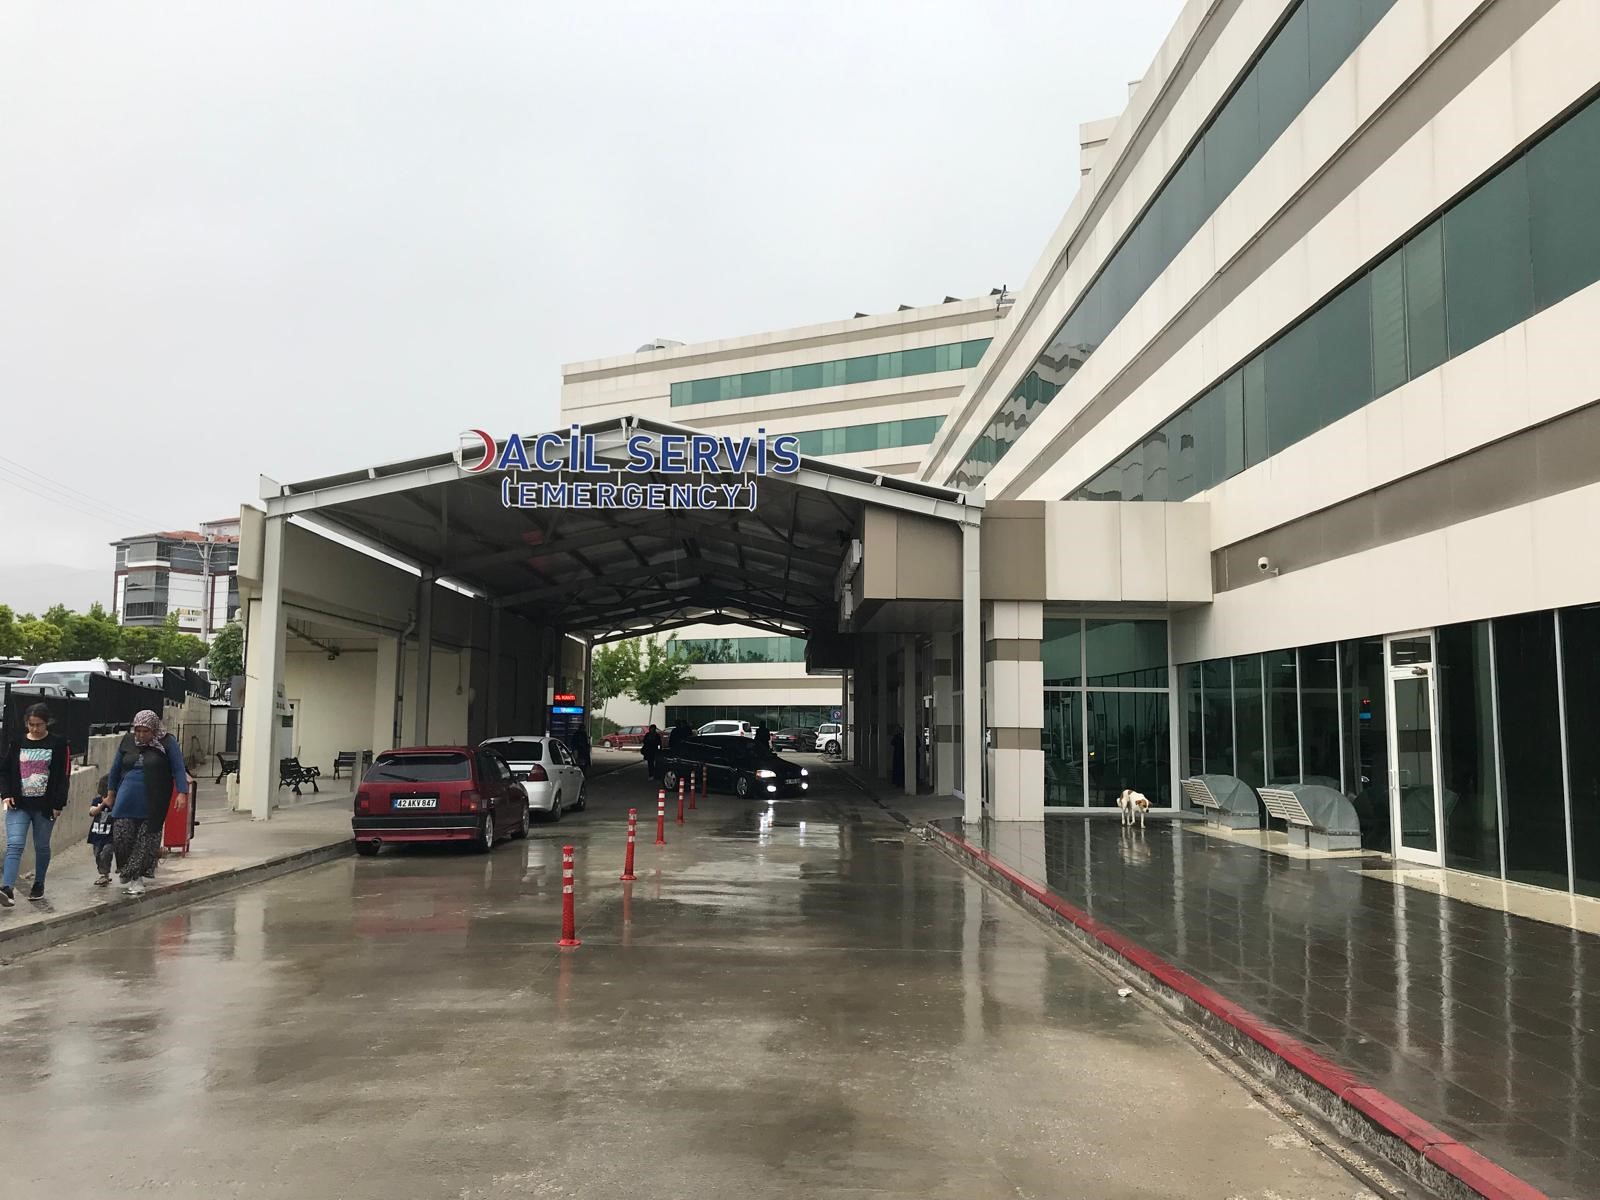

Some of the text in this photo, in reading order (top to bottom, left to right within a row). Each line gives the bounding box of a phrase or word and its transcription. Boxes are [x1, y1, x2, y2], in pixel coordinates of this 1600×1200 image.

[498, 423, 801, 476] ACİL SERVİS
[502, 476, 757, 512] (EMERGENCY)
[422, 799, 436, 807] 847
